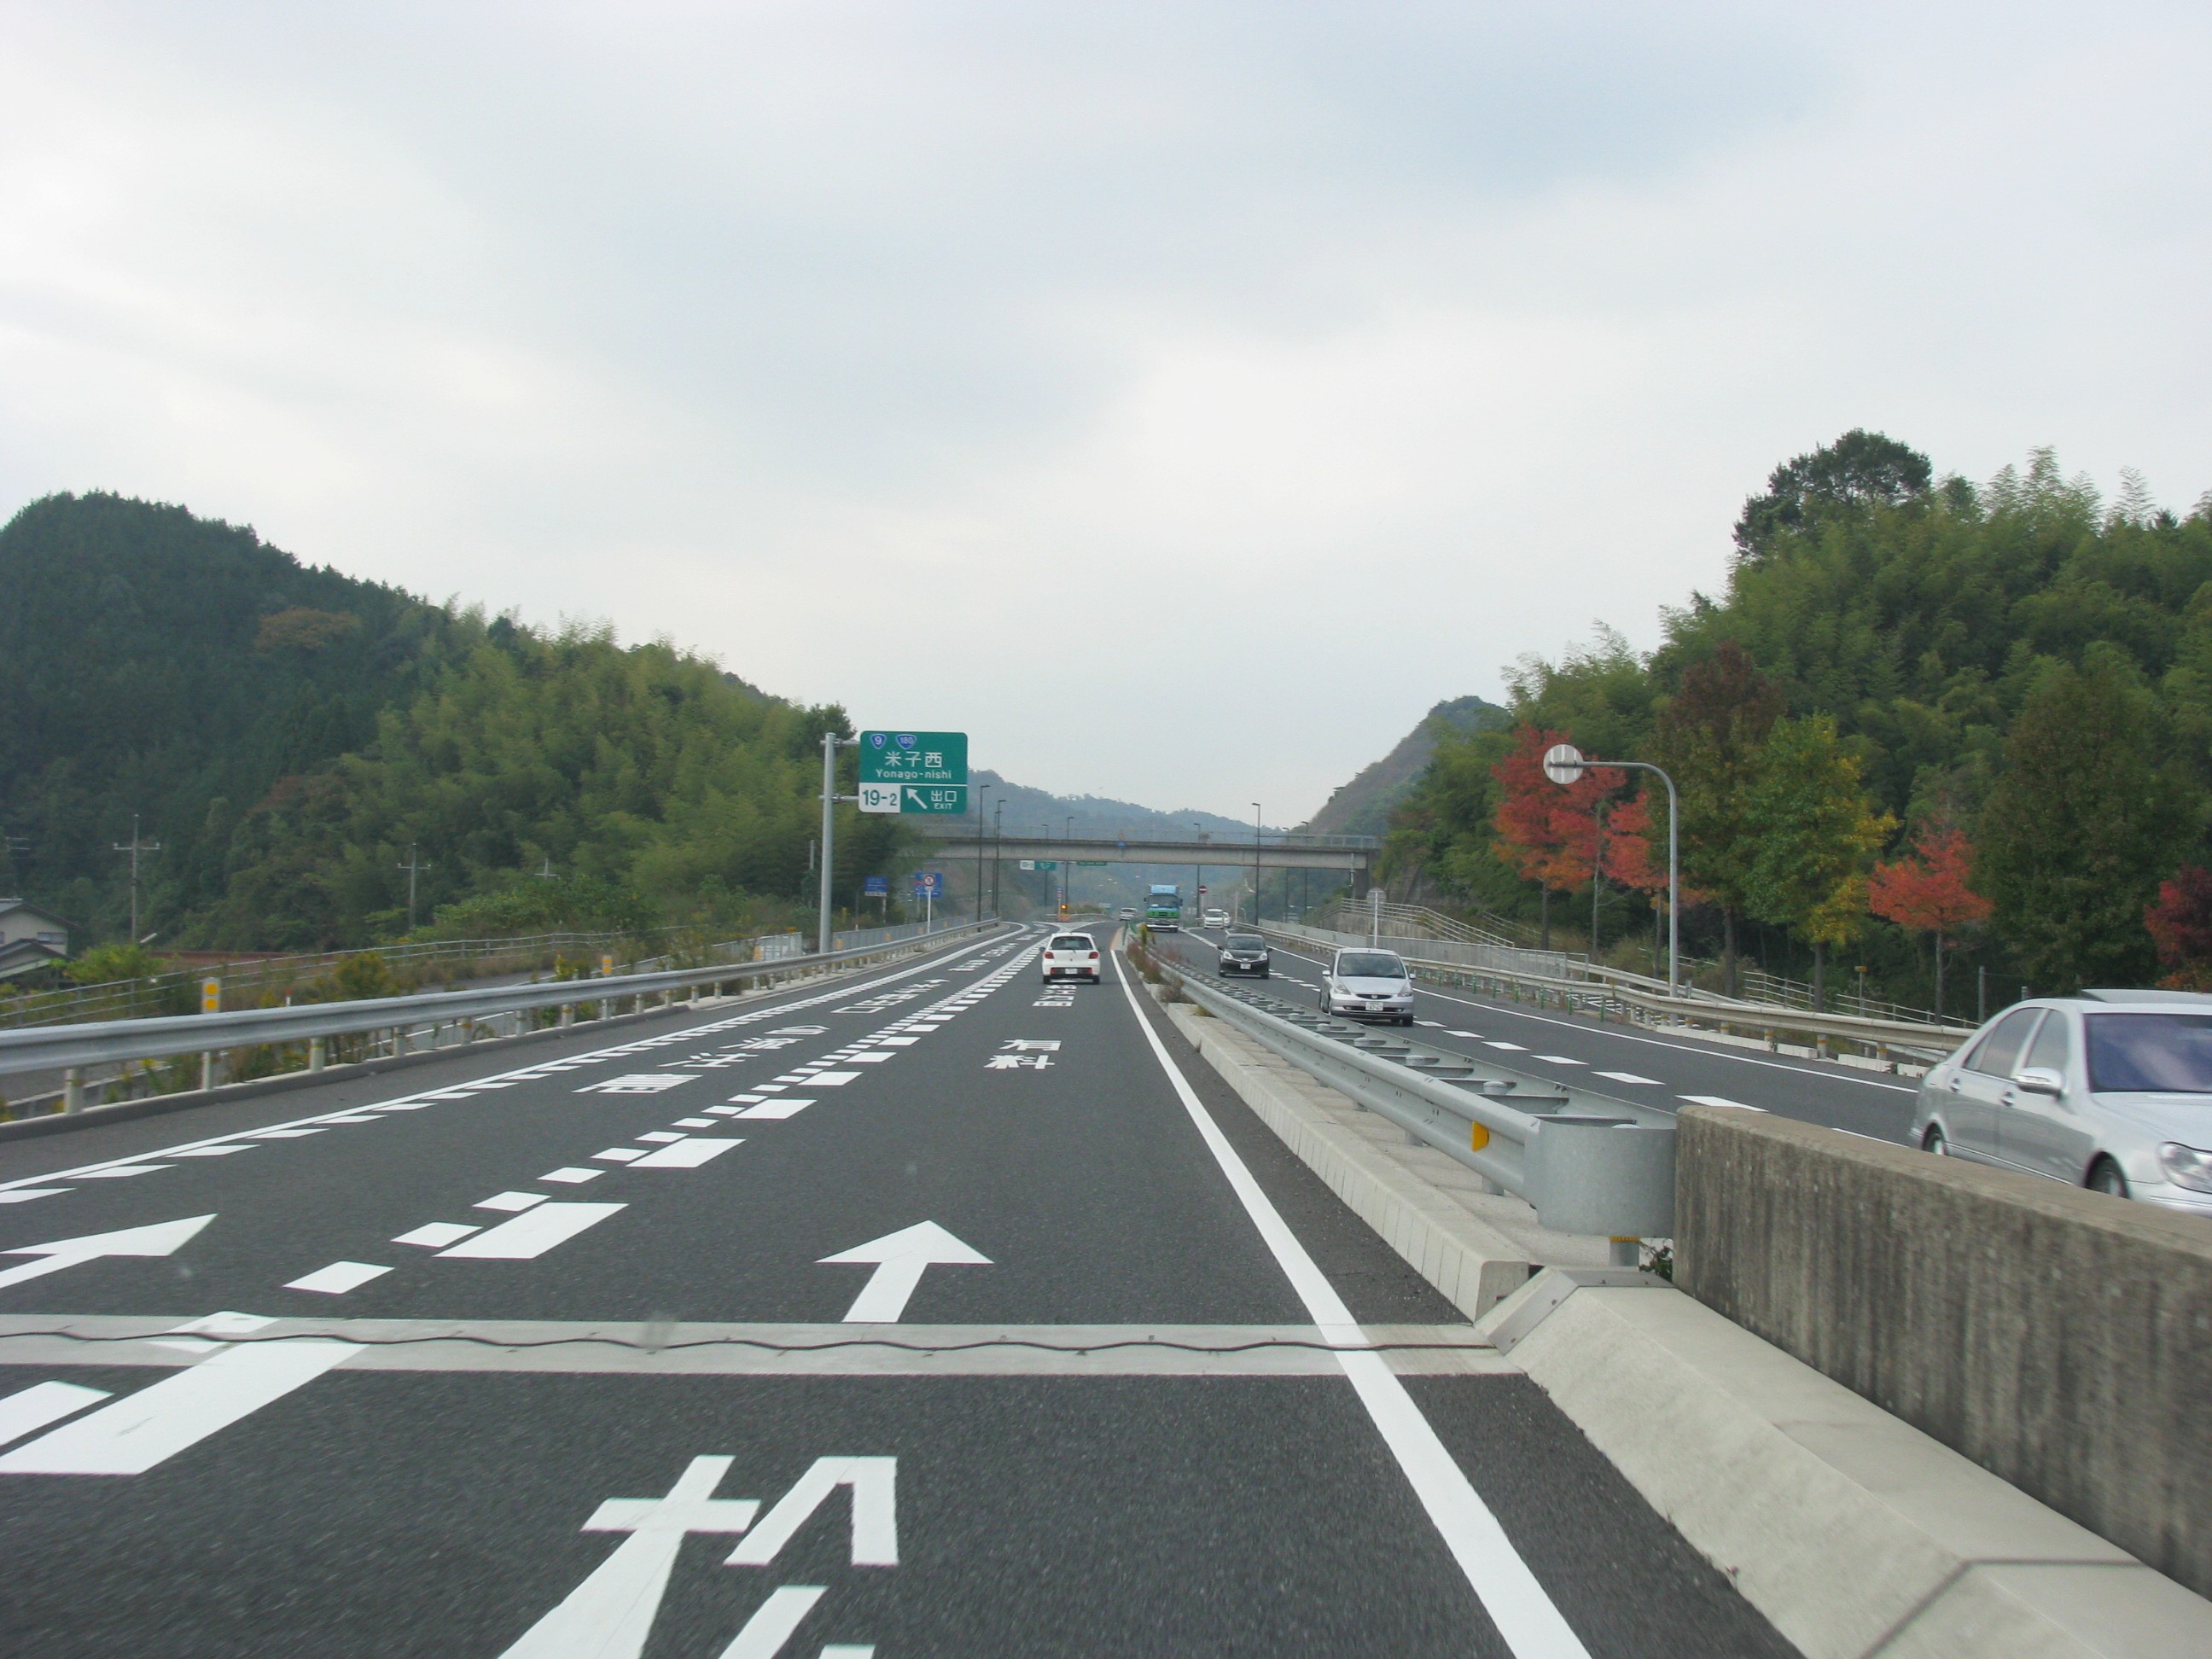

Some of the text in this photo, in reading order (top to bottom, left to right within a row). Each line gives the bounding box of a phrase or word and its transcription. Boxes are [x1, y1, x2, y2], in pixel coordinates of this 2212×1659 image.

[875, 736, 882, 745] 9
[885, 751, 942, 768] 米子西
[876, 769, 952, 779] Yonago-nishi
[862, 789, 898, 806] 19-2
[930, 790, 957, 802] 出口
[983, 1039, 1062, 1069] 有料
